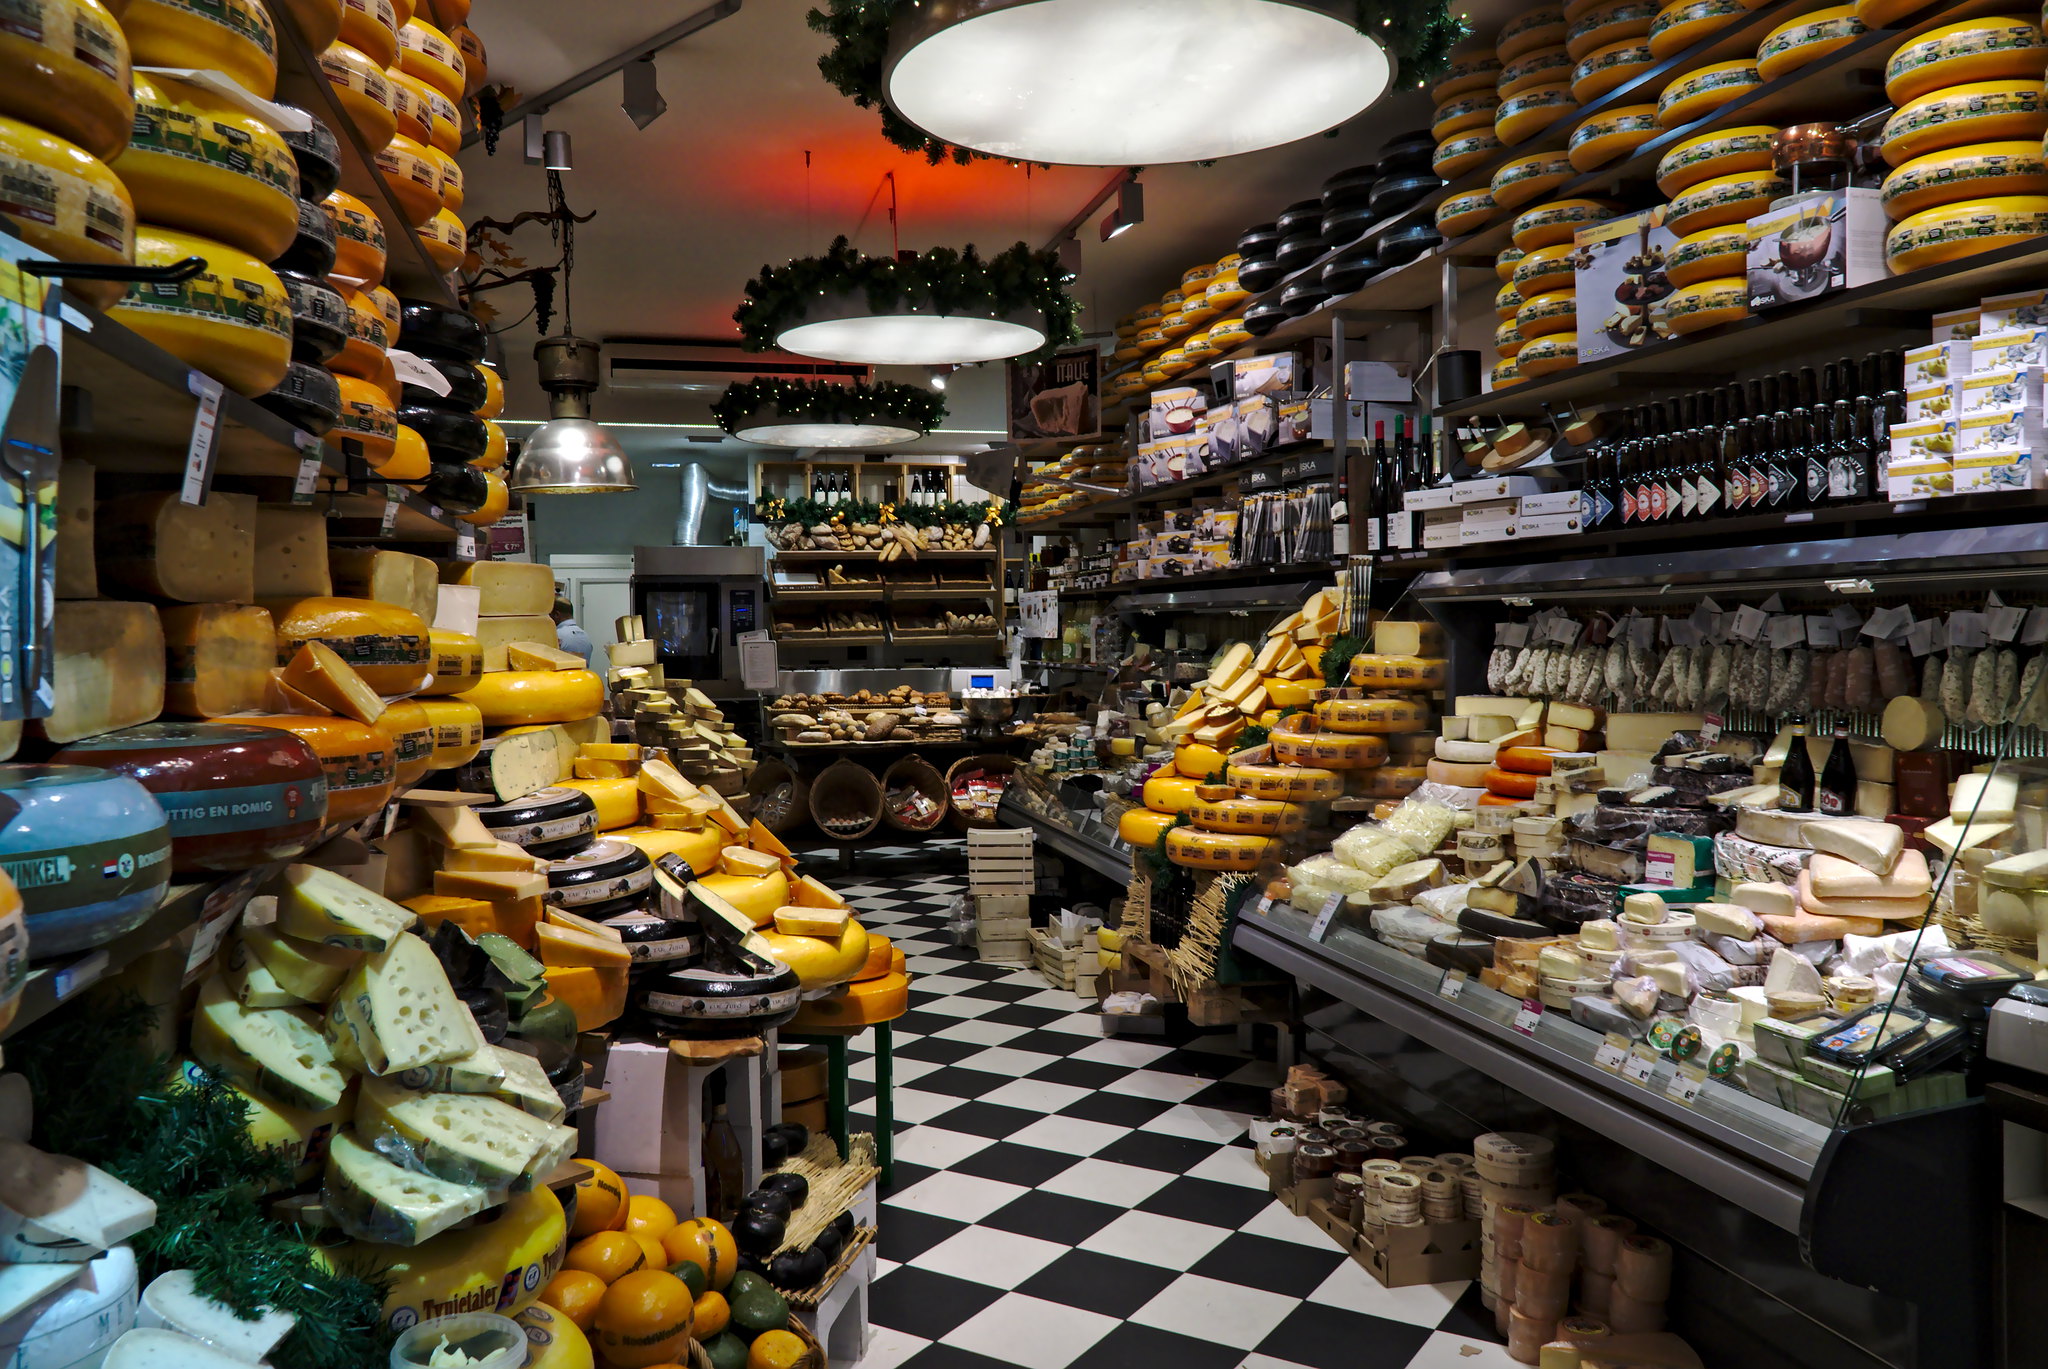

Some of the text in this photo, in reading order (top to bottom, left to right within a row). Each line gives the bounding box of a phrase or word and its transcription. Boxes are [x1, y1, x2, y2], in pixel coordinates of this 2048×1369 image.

[1581, 345, 1610, 357] BOSKA
[1056, 361, 1089, 383] ITALIE
[165, 801, 273, 820] ITTIG EN ROMIG
